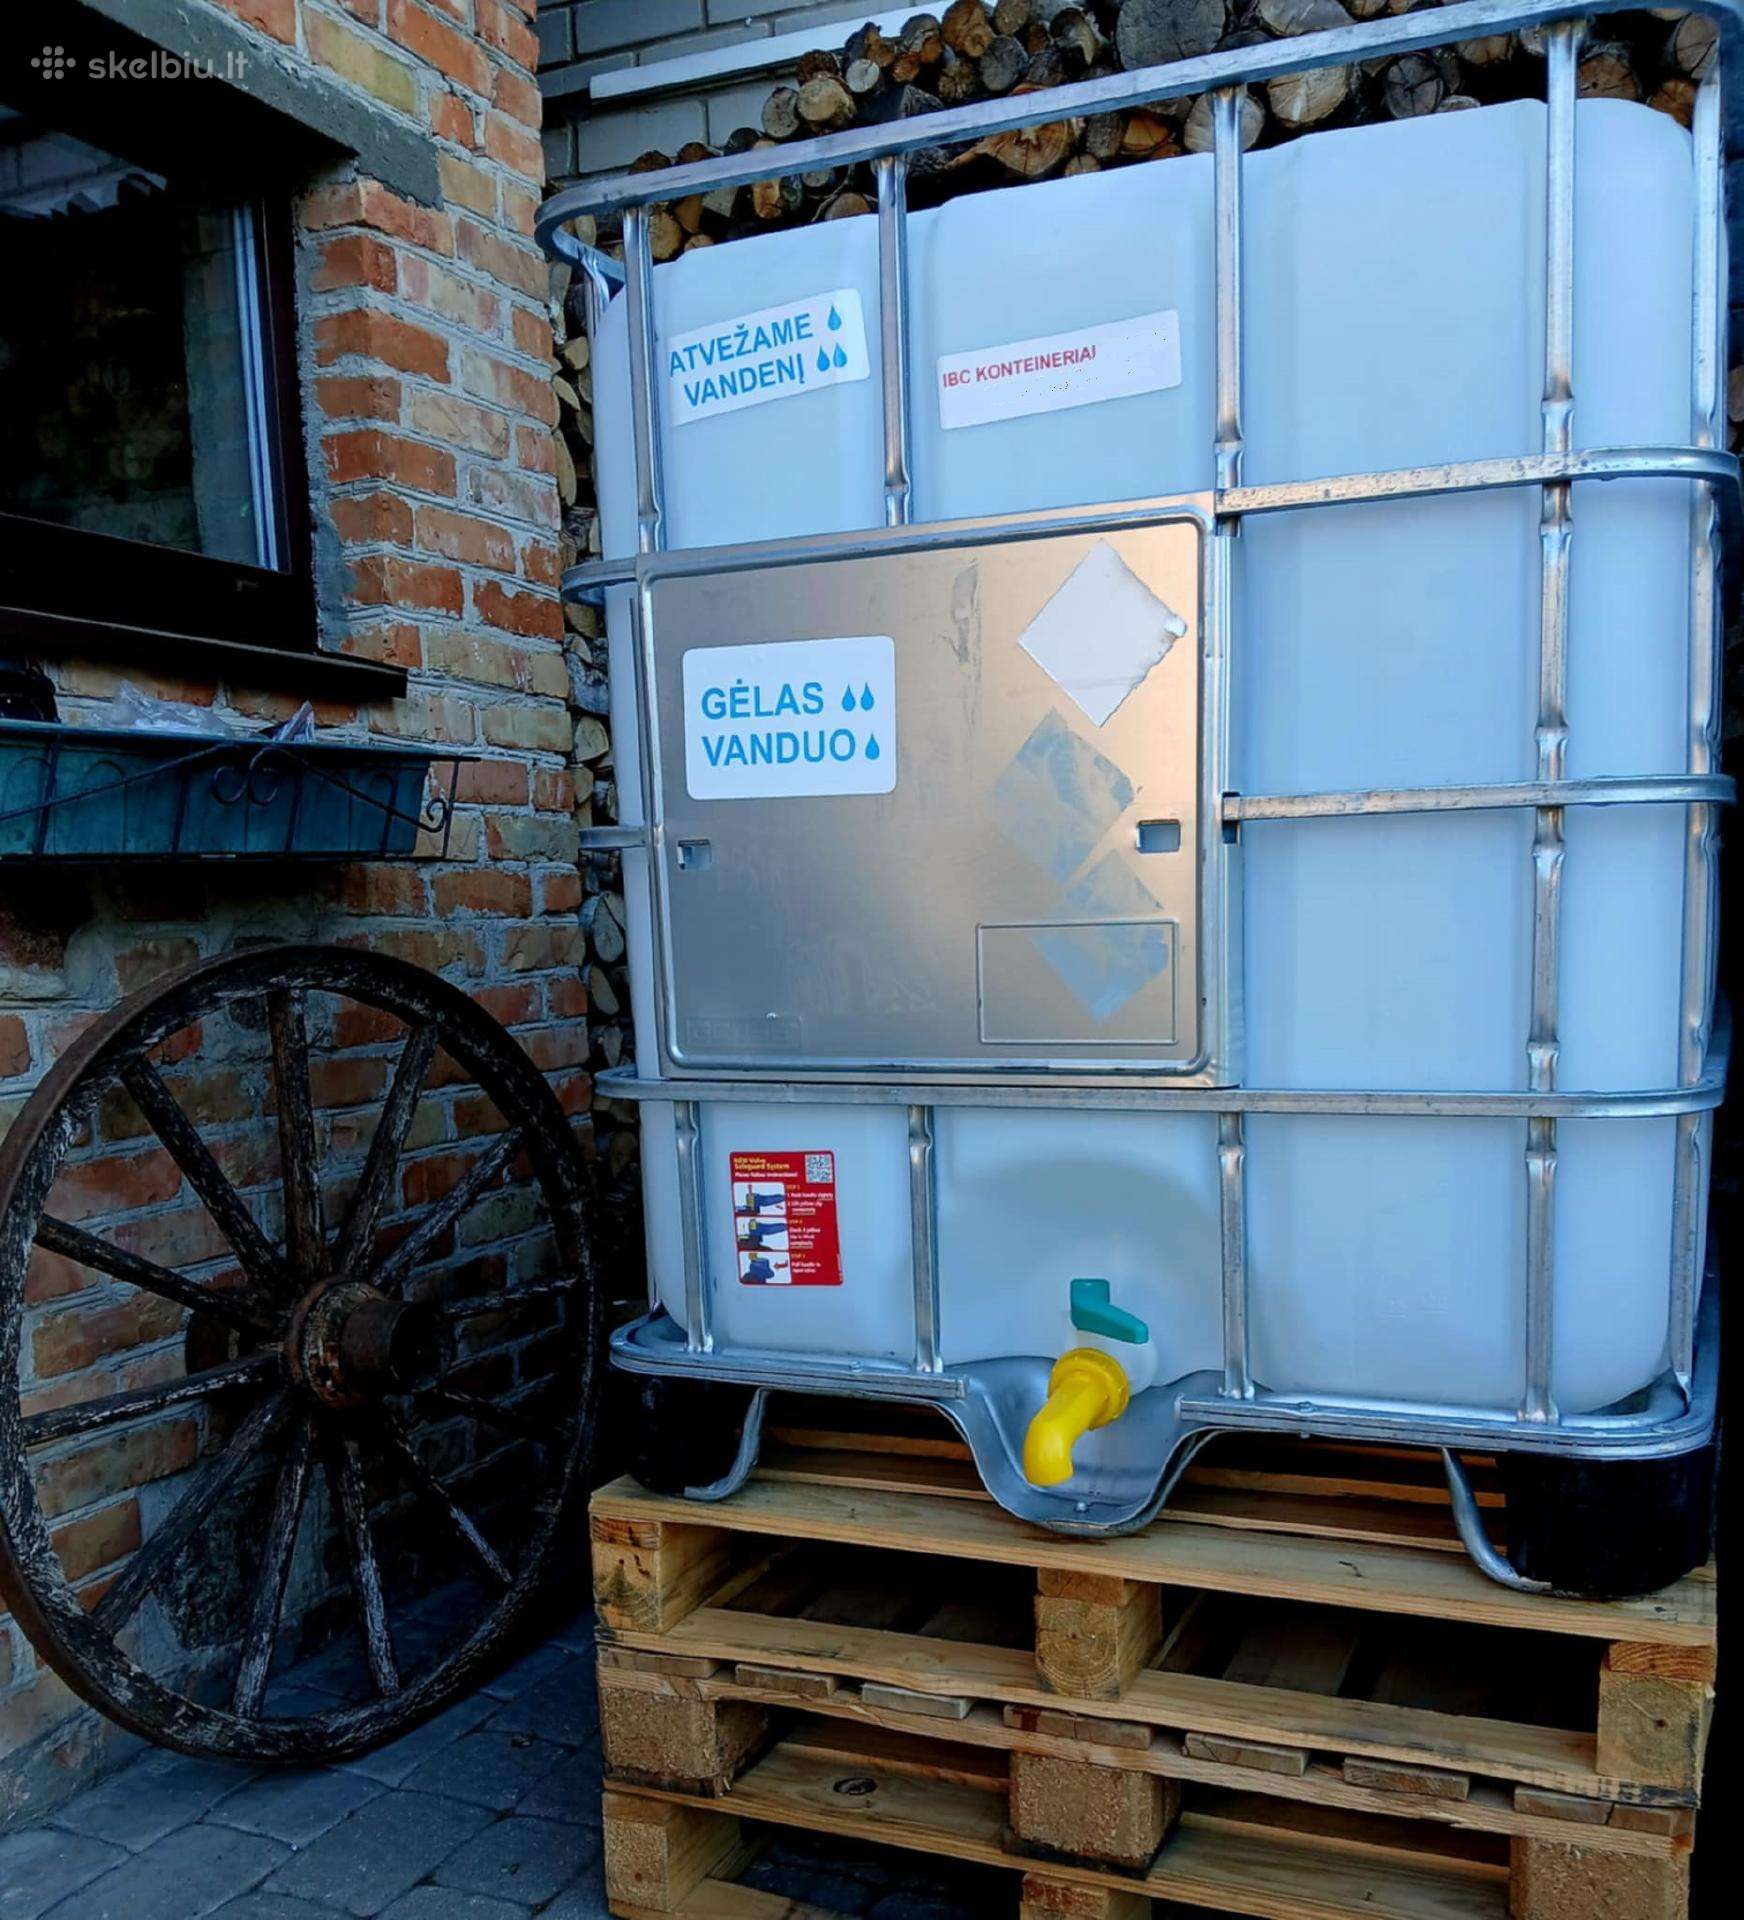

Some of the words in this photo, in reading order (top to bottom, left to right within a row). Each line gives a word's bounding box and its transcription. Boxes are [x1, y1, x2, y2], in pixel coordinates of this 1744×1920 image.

[669, 313, 814, 377] ATVEŽAME
[684, 353, 805, 407] VANDENĮ
[943, 369, 971, 388] IBC
[976, 345, 1096, 383] KONTEINERIAI
[701, 678, 824, 720] GĖLAS
[701, 728, 856, 767] VANDUO
[767, 1163, 790, 1171] System
